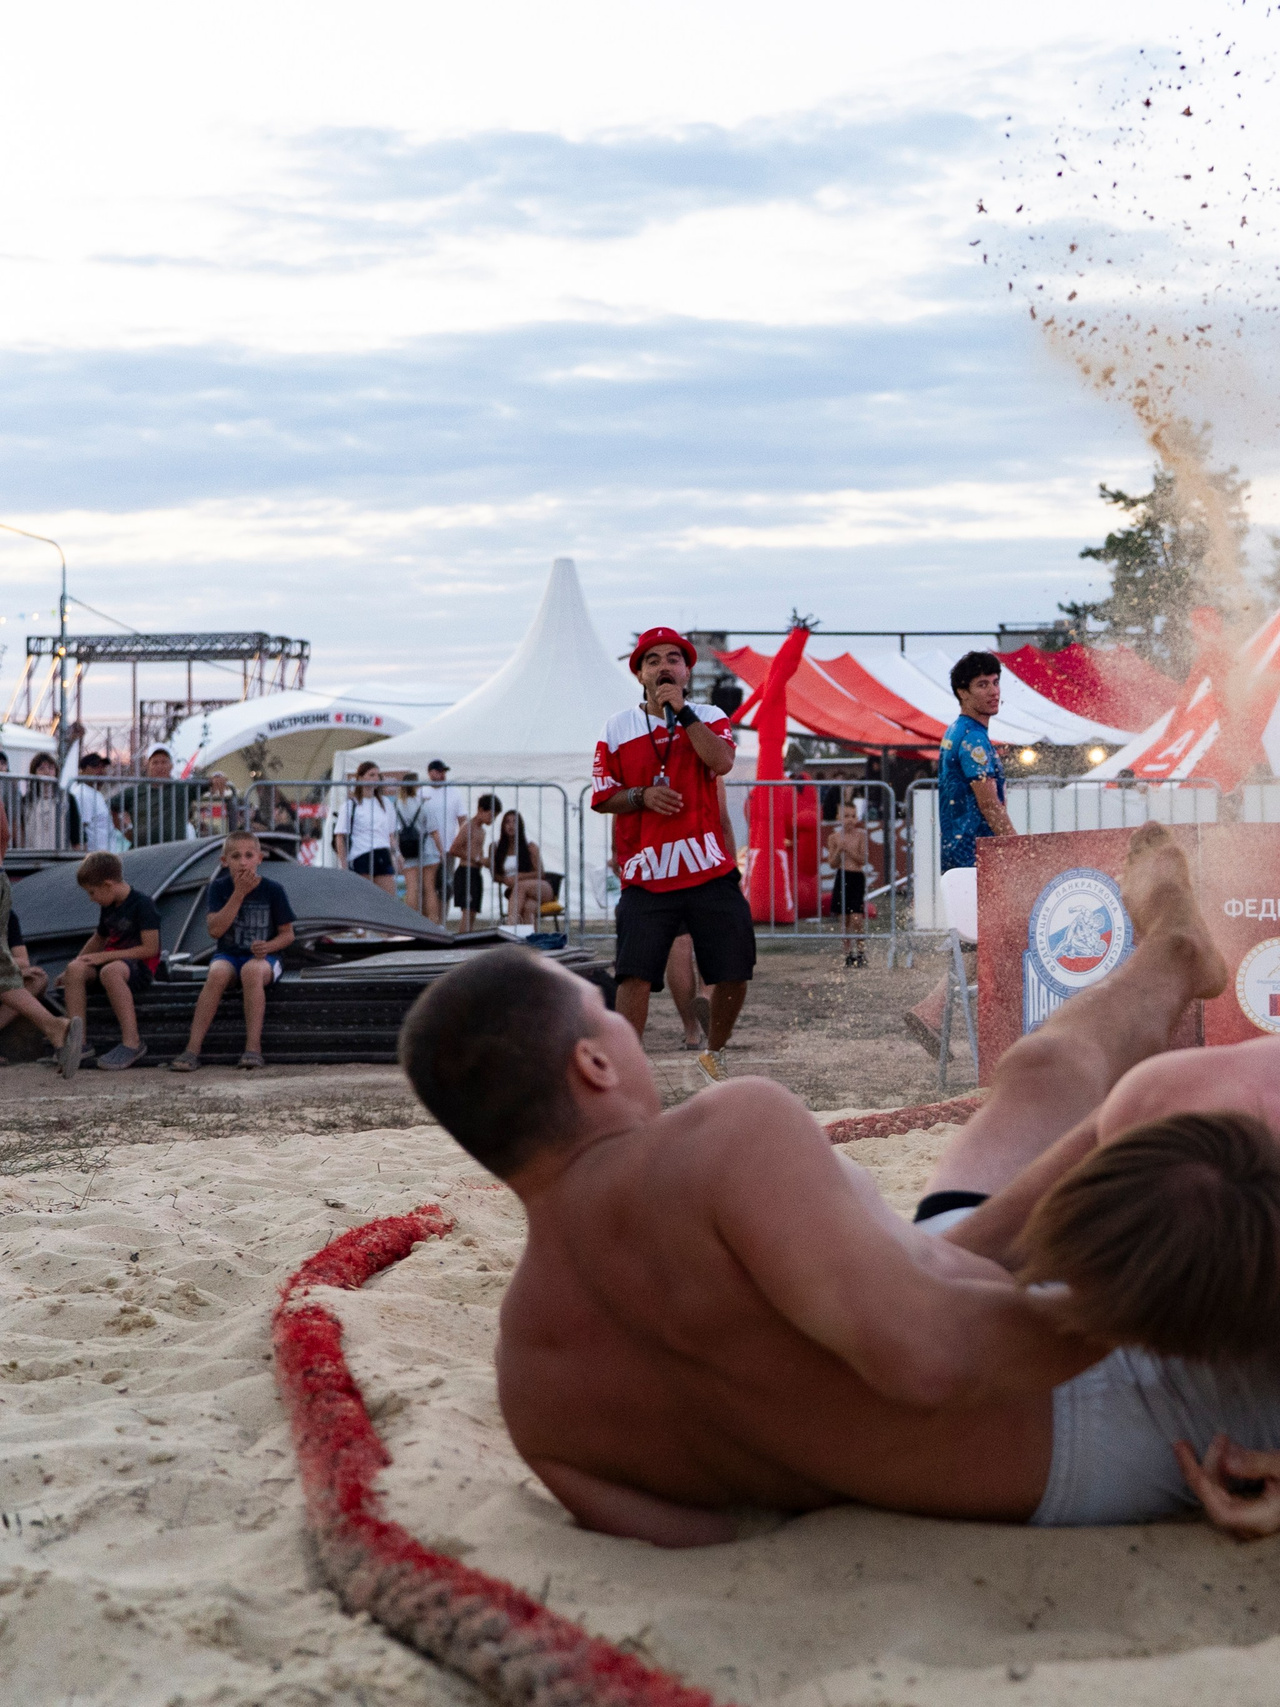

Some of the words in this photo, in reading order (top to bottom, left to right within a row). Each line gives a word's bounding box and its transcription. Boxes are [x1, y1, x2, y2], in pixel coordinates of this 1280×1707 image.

[268, 712, 330, 732] НАСТРОЕНИЕ
[1038, 906, 1057, 973] ФЕДЕРАЦИЯ
[1055, 880, 1118, 914] ПАНКРАТИОНА
[1102, 926, 1123, 971] РОССИИ
